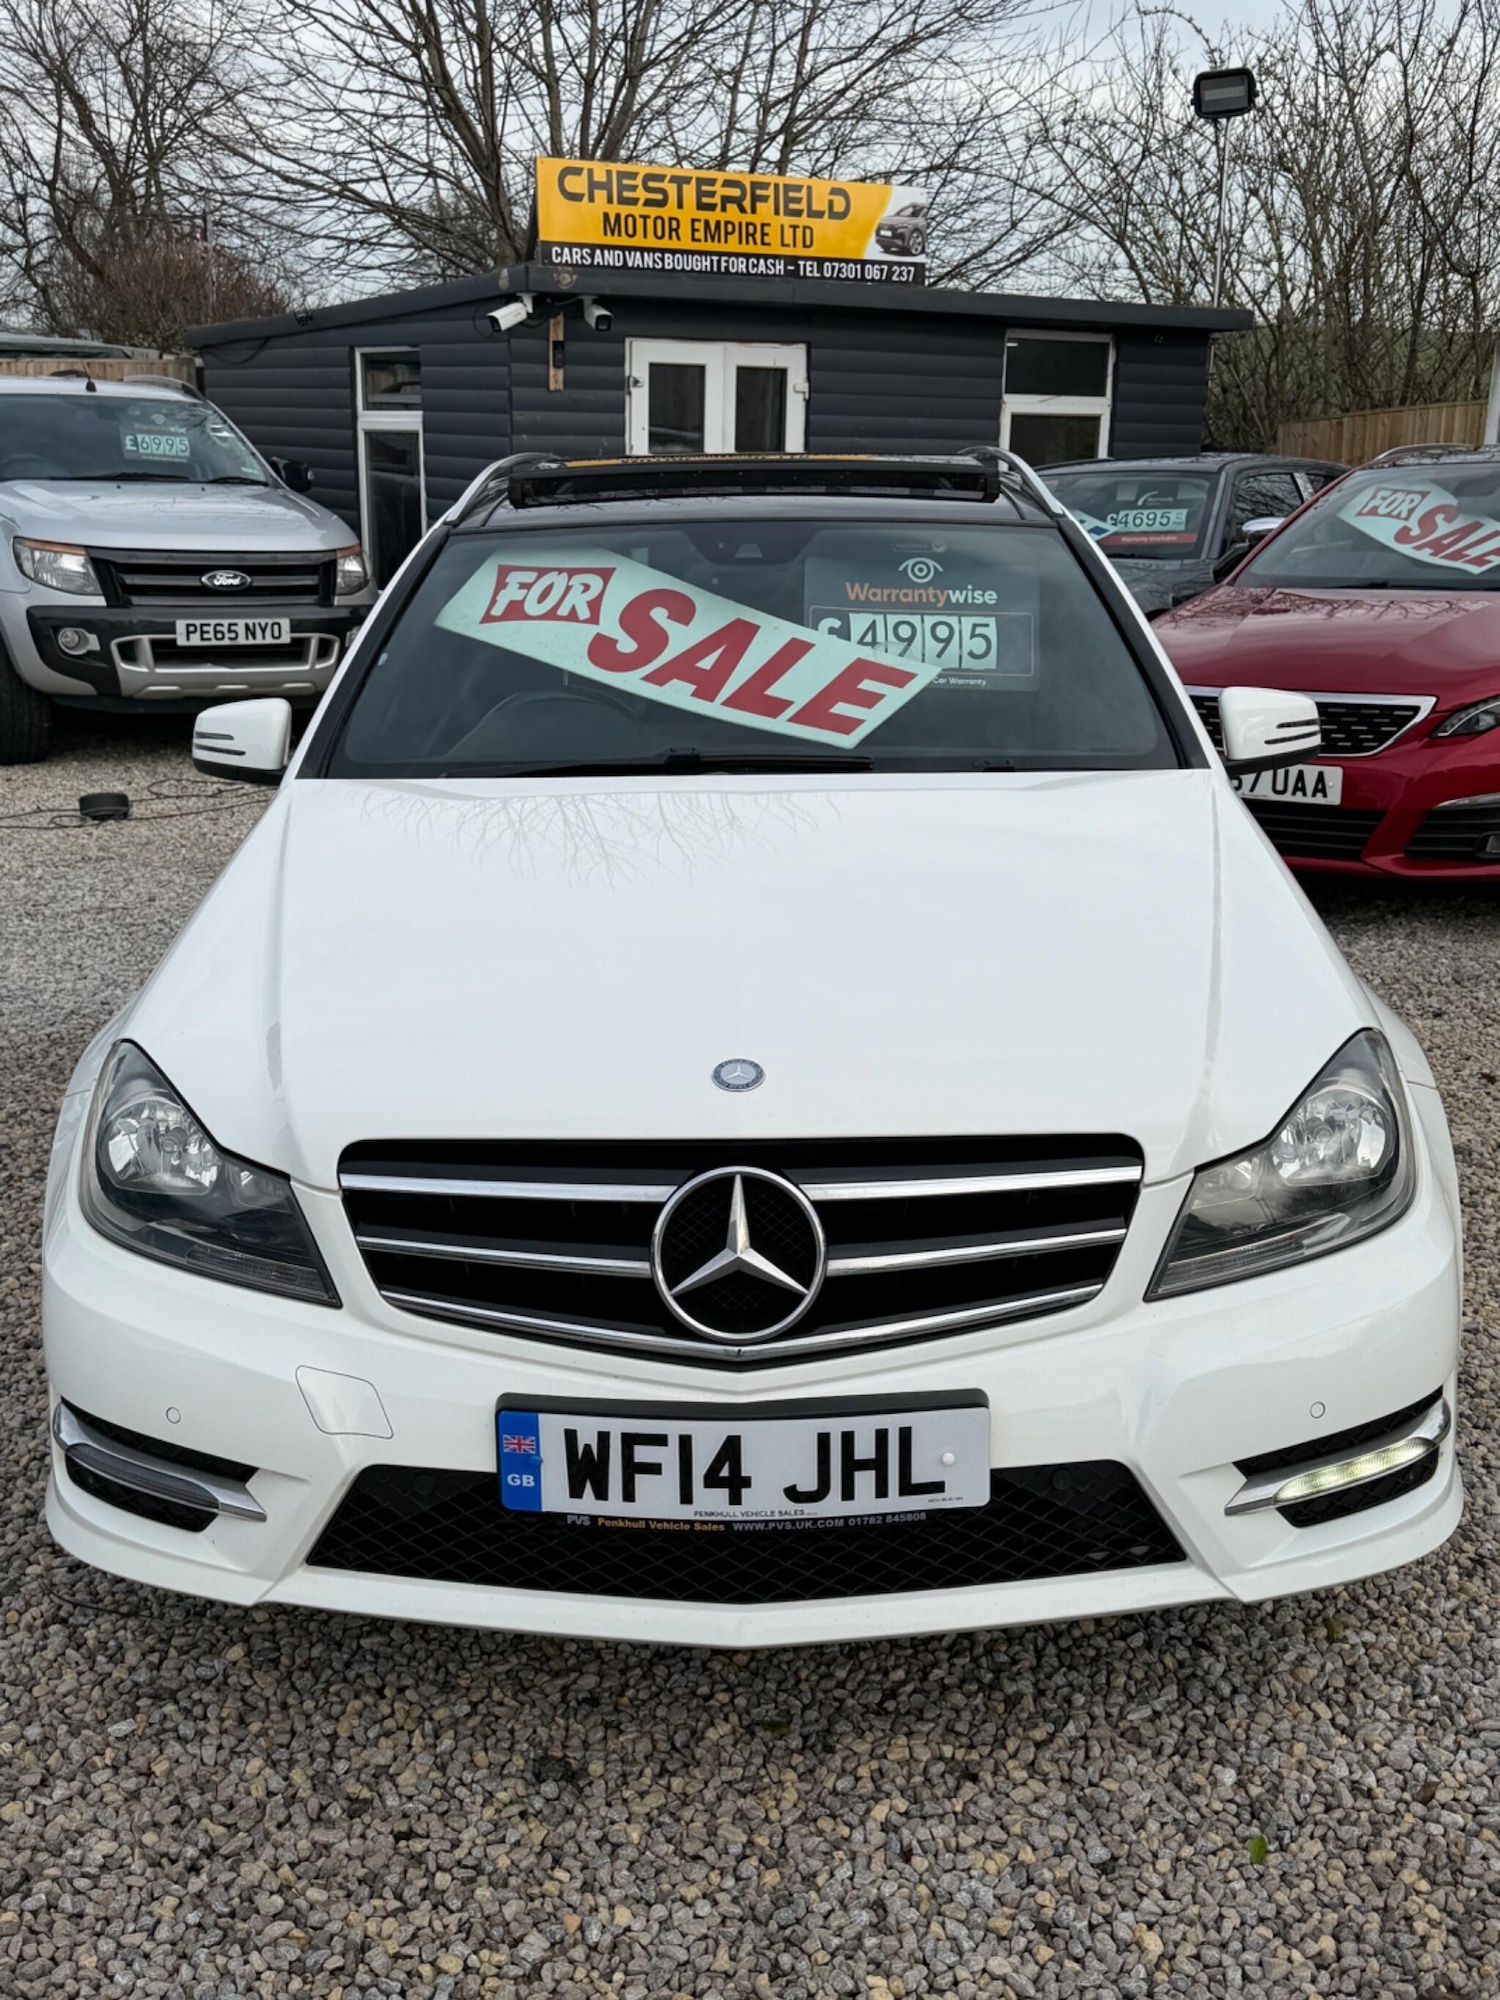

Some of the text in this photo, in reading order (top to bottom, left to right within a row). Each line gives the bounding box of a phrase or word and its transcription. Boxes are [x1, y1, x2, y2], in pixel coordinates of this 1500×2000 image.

[557, 166, 852, 221] CHESTERFIELD
[602, 211, 814, 249] MOTOR EMPIRE LTD
[551, 246, 591, 266] CARS
[594, 248, 623, 268] AND
[625, 251, 663, 270] VANS
[664, 253, 719, 273] BOUGHT
[721, 256, 746, 273] FOR
[749, 257, 784, 276] CASH
[798, 260, 821, 278] TEL
[823, 262, 861, 280] 07301
[865, 264, 888, 281] 067
[892, 266, 915, 283] 237
[125, 434, 189, 454] £6995
[1362, 489, 1422, 519] FOR
[213, 573, 241, 586] Ford
[845, 582, 998, 608] Warrantywise
[186, 622, 239, 642] PE65
[491, 568, 919, 736] FOR SALE
[949, 676, 987, 687] Warranty
[1272, 767, 1328, 798] UAA
[564, 1426, 946, 1506] WF14 JHL
[507, 1474, 535, 1488] GB
[566, 1511, 927, 1532] PVS Penkhull Vehicle Sales WWW.PVS.UK.COM 01782 845808
[694, 1510, 738, 1518] PENKHULL
[741, 1510, 777, 1518] VEHICLE
[778, 1509, 805, 1517] SALES
